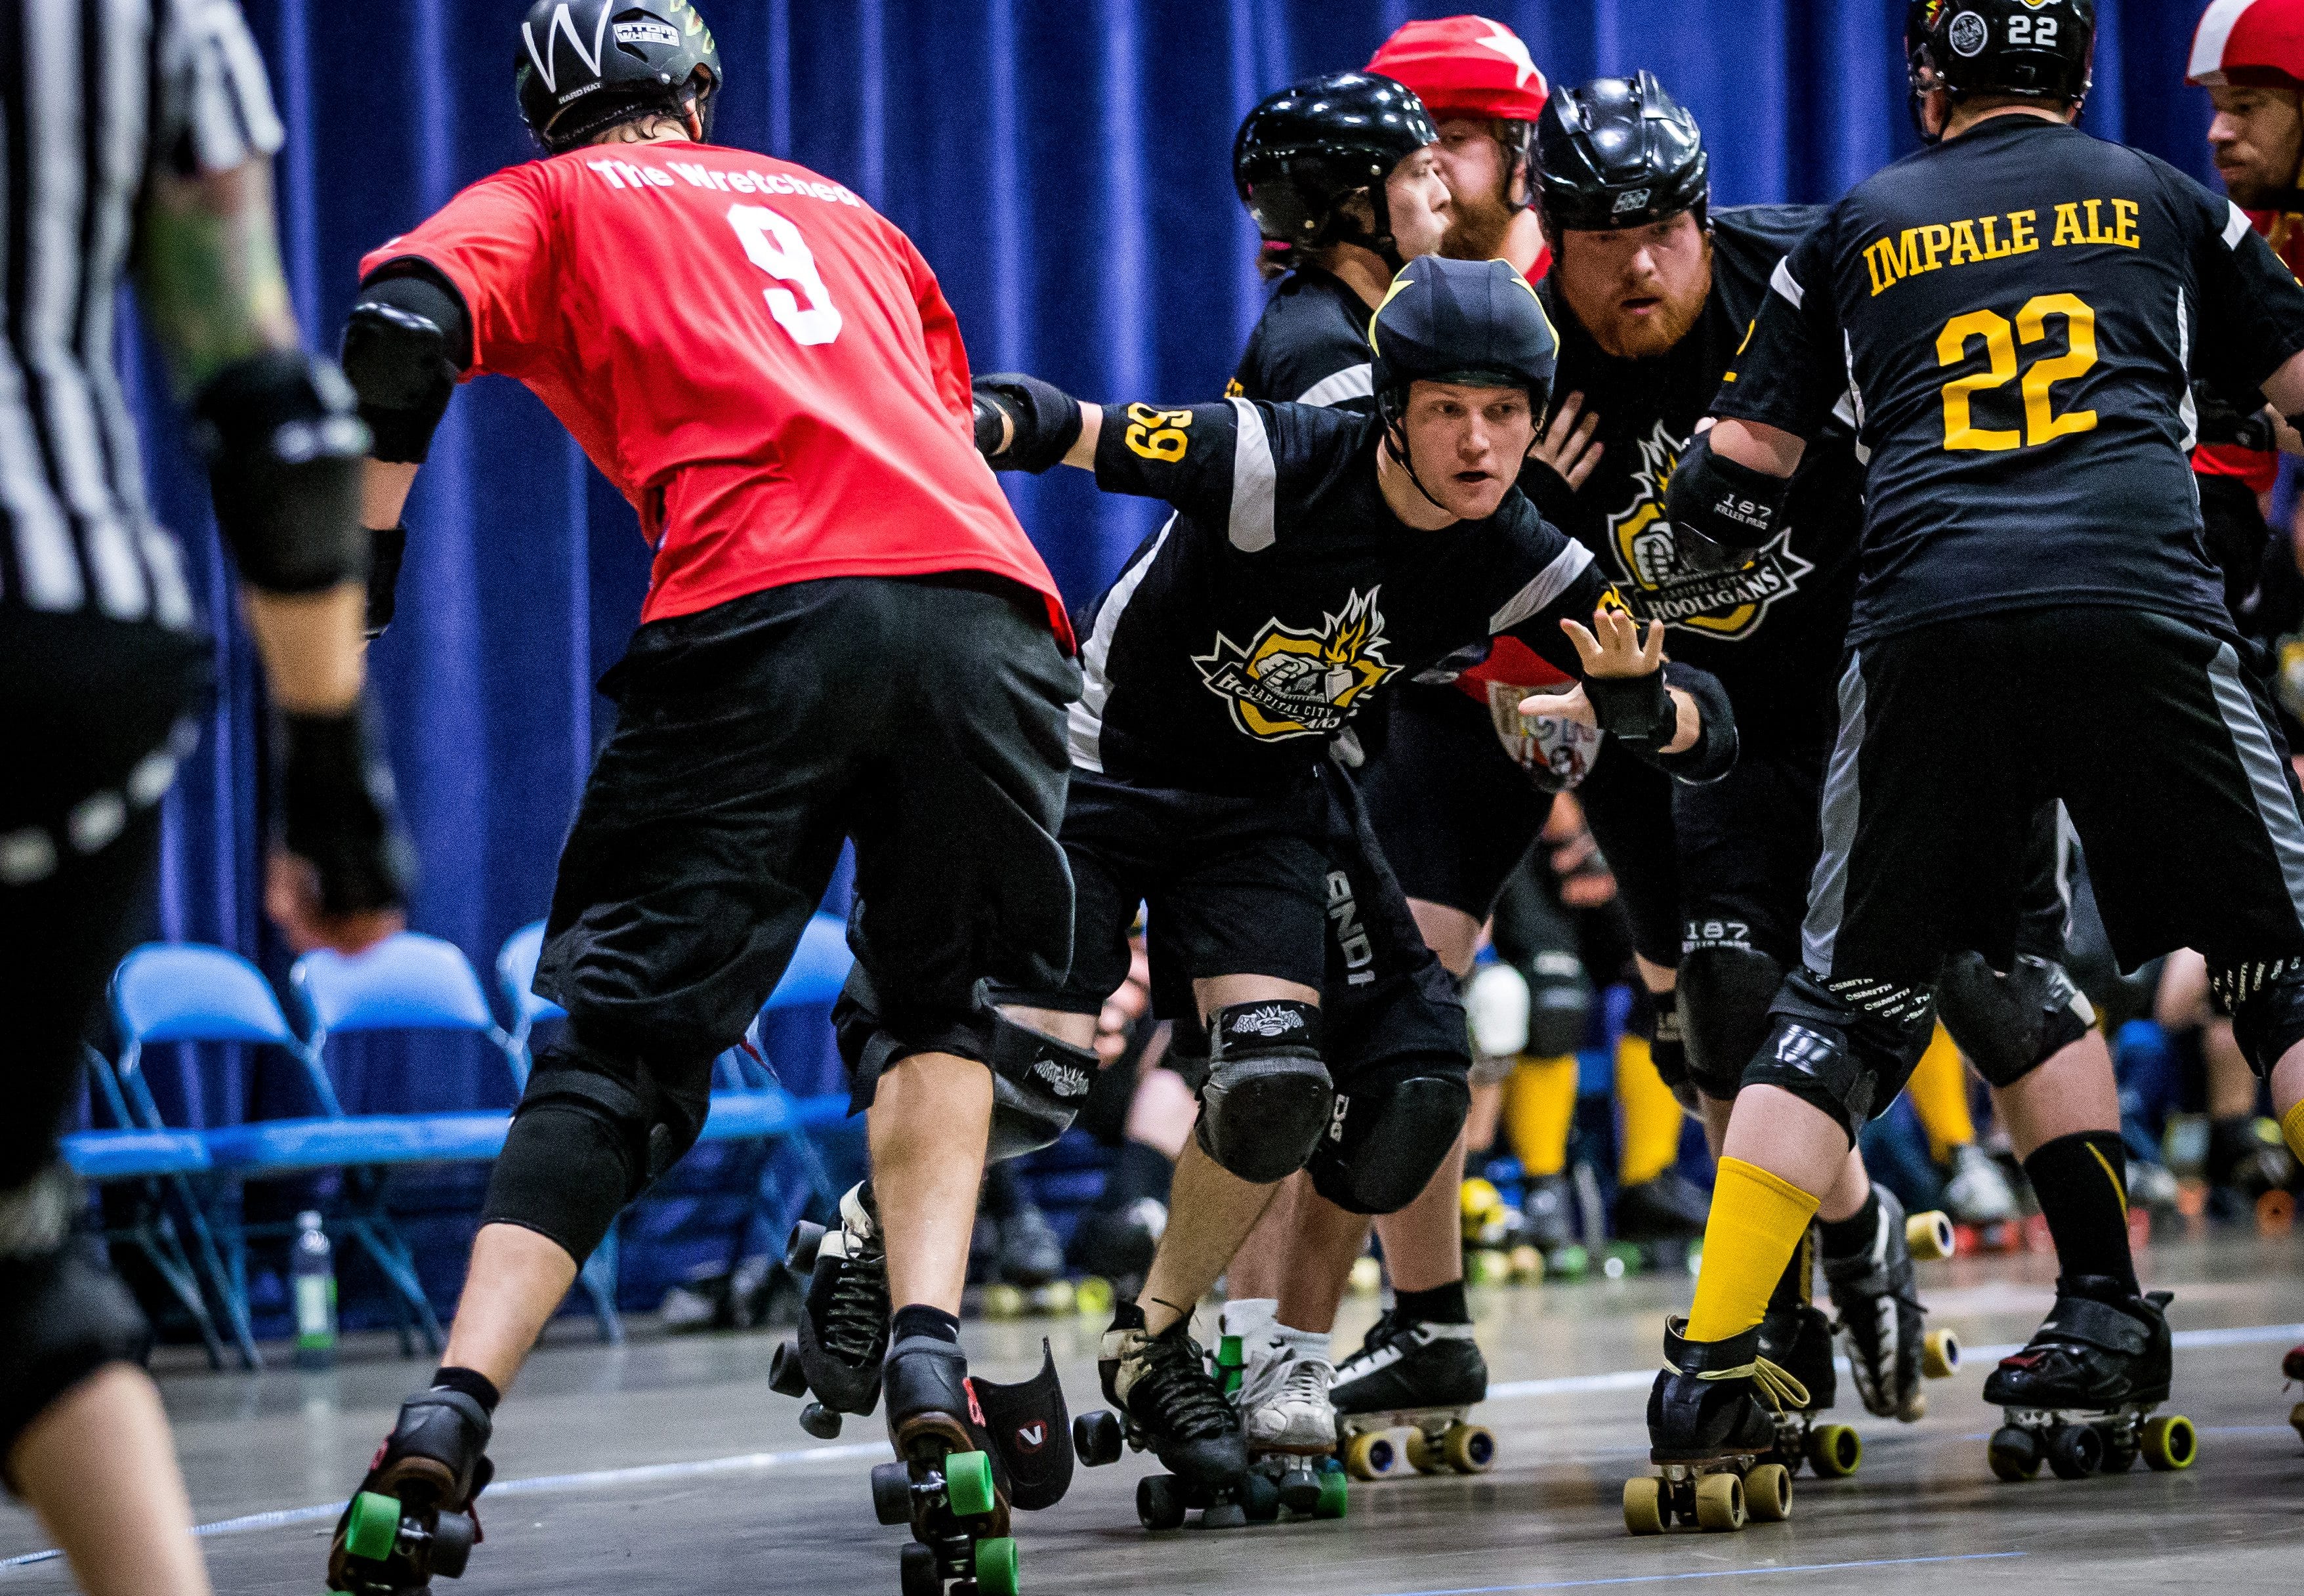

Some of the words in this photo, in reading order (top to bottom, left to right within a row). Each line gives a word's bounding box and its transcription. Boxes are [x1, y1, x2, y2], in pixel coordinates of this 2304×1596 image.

[617, 24, 678, 37] ATOM
[2009, 15, 2058, 47] 22
[587, 159, 675, 190] The
[1862, 209, 2040, 297] IMPALE
[2051, 198, 2141, 249] ALE
[727, 204, 843, 346] 9
[1936, 293, 2099, 451] 22
[1125, 402, 1192, 463] 69
[1723, 494, 1773, 518] 187
[1249, 684, 1299, 714] CAPITAL
[1304, 705, 1334, 718] CITY
[1686, 921, 1749, 939] 187
[1853, 984, 1893, 1000] SMITH
[1872, 988, 1910, 1009] SMITH
